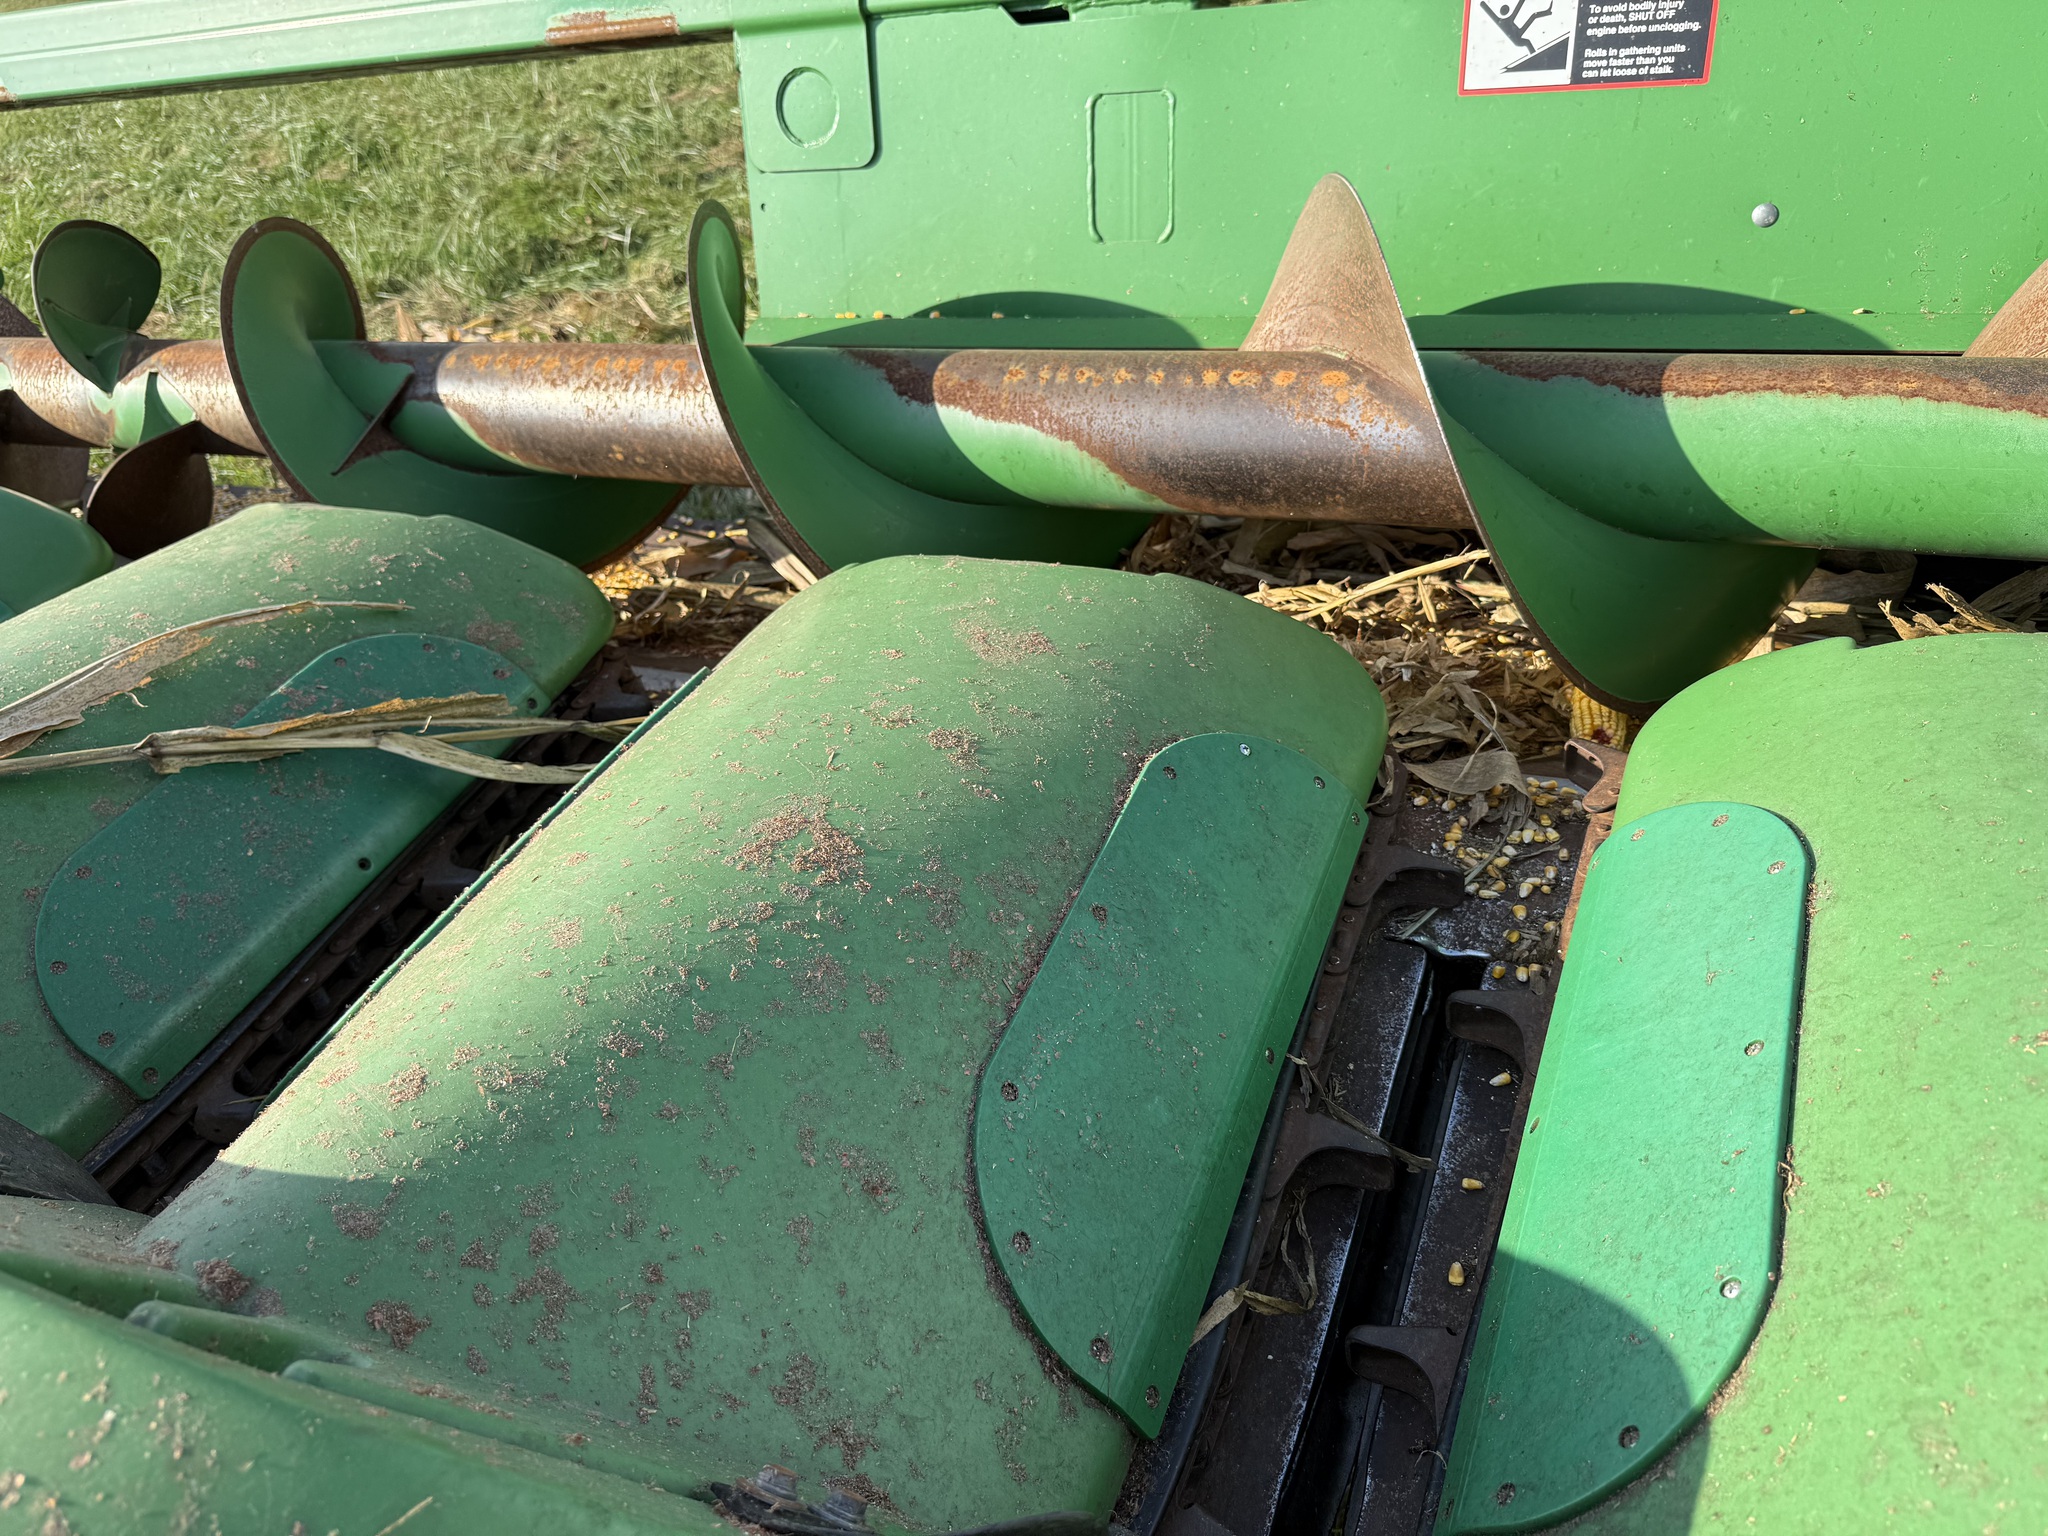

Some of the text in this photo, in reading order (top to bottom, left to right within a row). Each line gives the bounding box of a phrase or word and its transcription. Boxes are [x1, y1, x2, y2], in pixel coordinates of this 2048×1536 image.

[1589, 1, 1684, 13] To avoid bodily injury
[1588, 10, 1676, 24] or death, SHUT OFF
[1586, 21, 1701, 37] engine before unclogging.
[1585, 44, 1685, 57] Rolls in gathering units
[1609, 57, 1635, 66] faster
[1636, 56, 1656, 65] than
[1657, 56, 1675, 65] you
[1582, 65, 1674, 78] can let loose of stalk.
